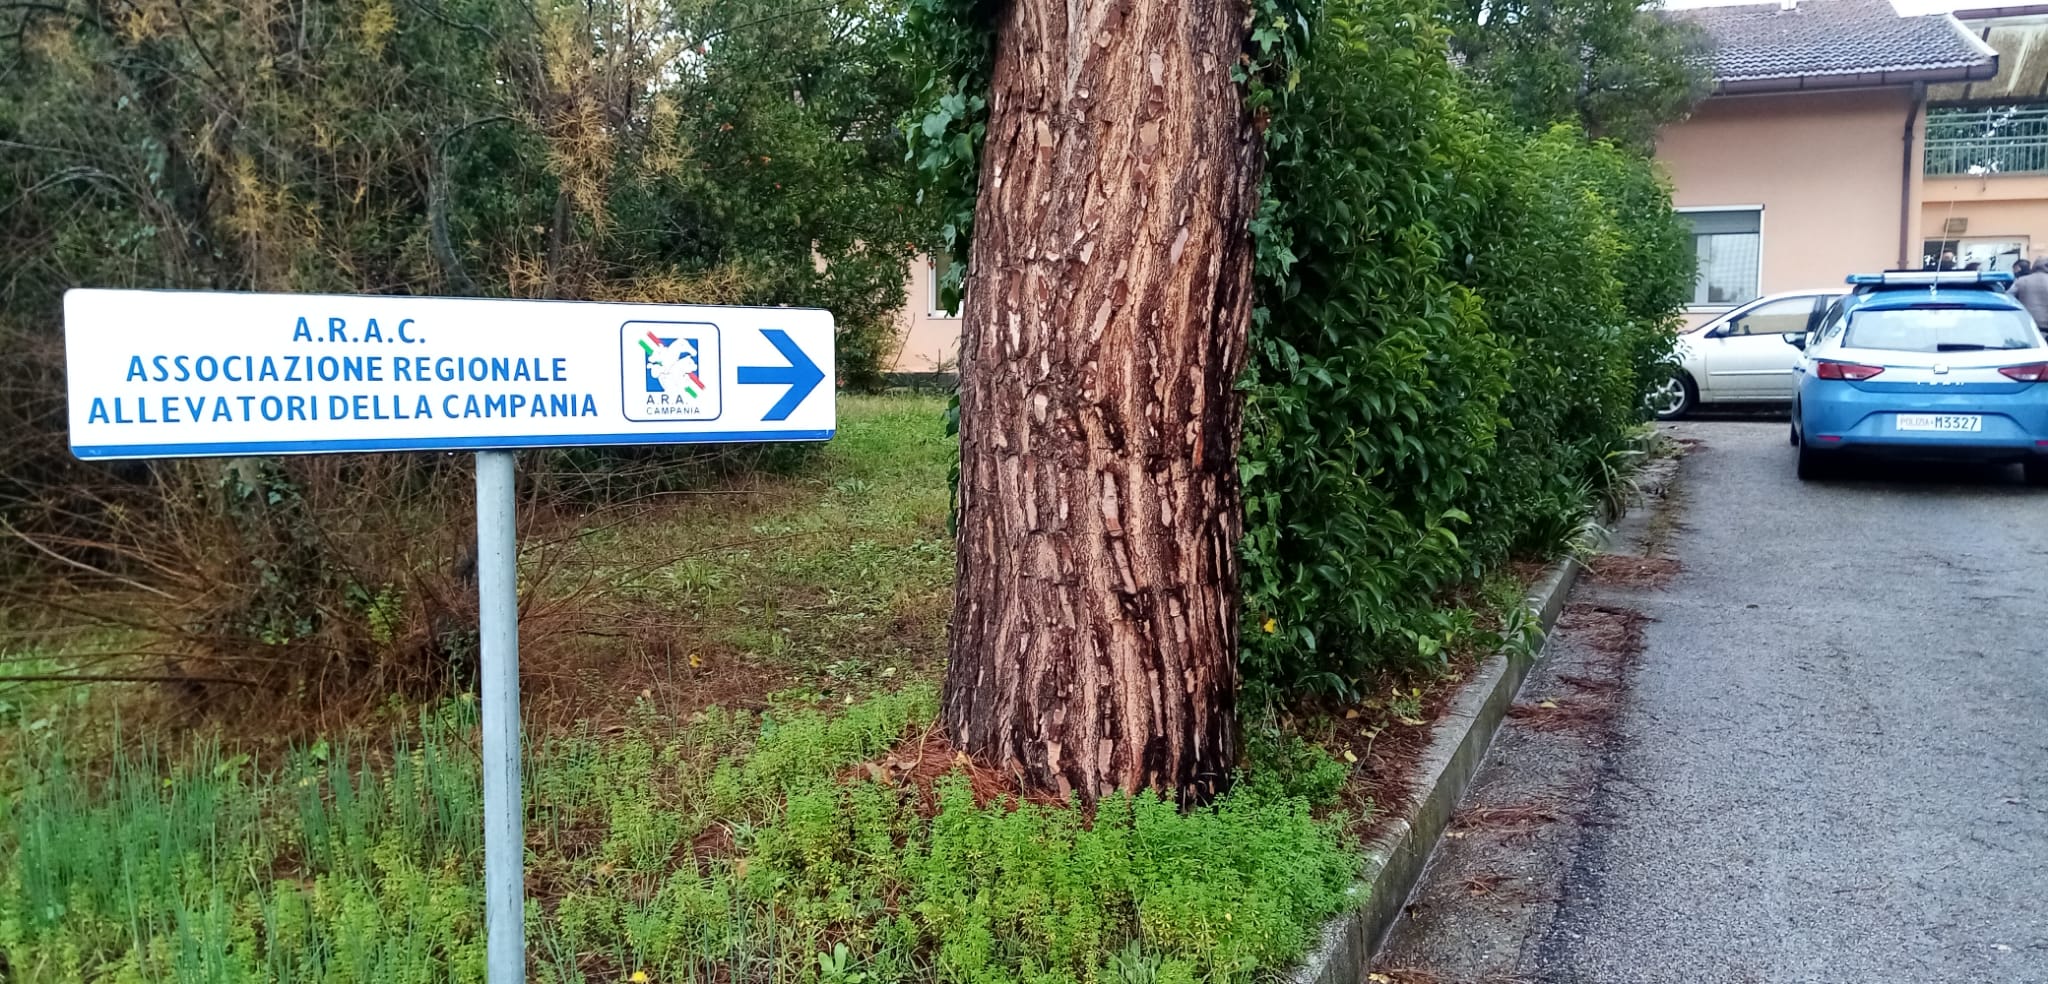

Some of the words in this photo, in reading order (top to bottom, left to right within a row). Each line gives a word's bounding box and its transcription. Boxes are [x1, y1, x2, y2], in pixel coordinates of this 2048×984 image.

[293, 317, 425, 343] A.R.A.C.
[127, 355, 383, 382] ASSOCIAZIONE
[394, 357, 566, 381] REGIONALE
[88, 396, 317, 424] ALLEVATORI
[329, 395, 432, 420] DELLA
[443, 394, 597, 418] CAMPANIA
[646, 394, 689, 405] A.R.A.
[646, 406, 701, 416] CAMPANIA
[1935, 416, 1978, 431] M3327
